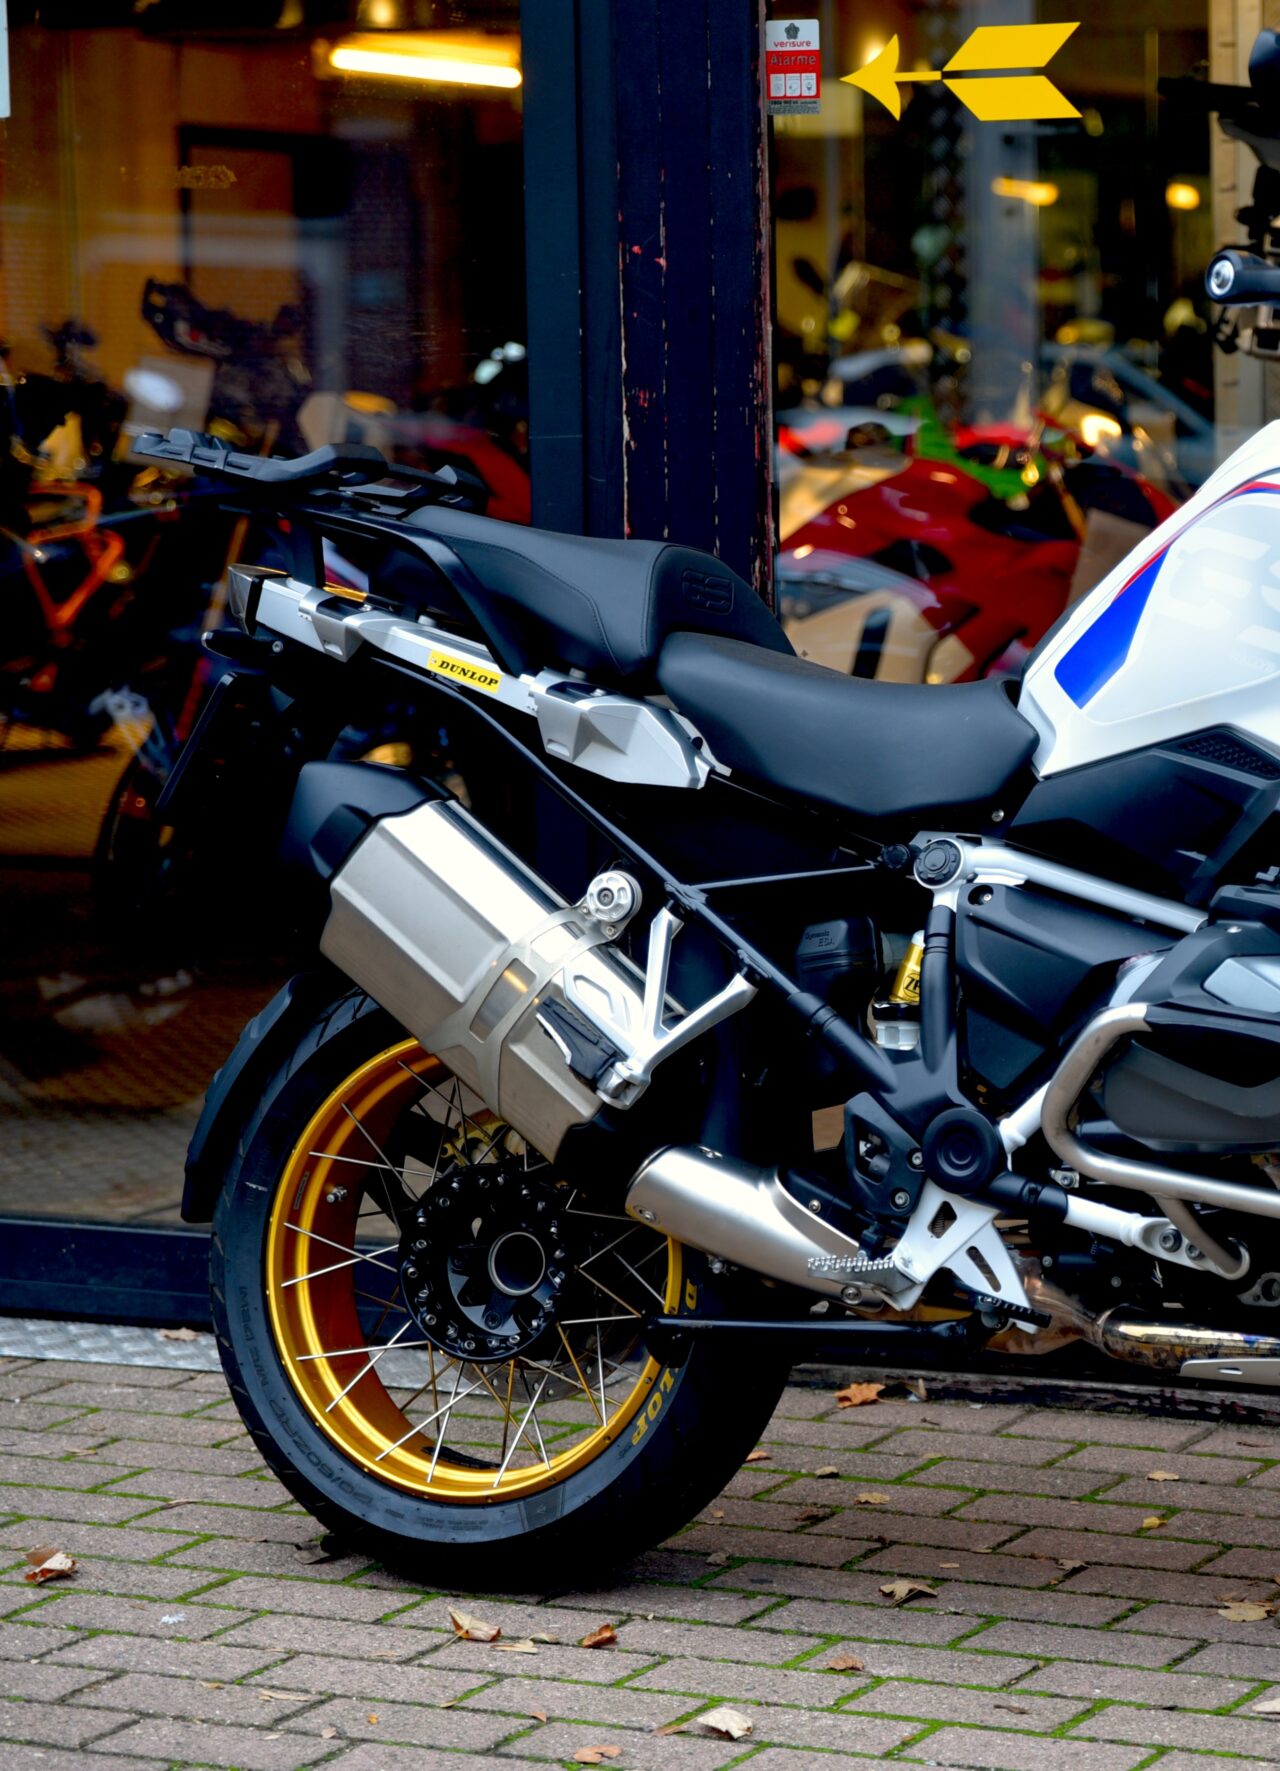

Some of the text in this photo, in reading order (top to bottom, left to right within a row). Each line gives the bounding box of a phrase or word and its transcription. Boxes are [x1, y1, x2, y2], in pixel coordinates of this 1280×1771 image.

[773, 40, 812, 48] verisure
[438, 660, 498, 686] DUNLOP
[631, 1278, 698, 1446] DLOP
